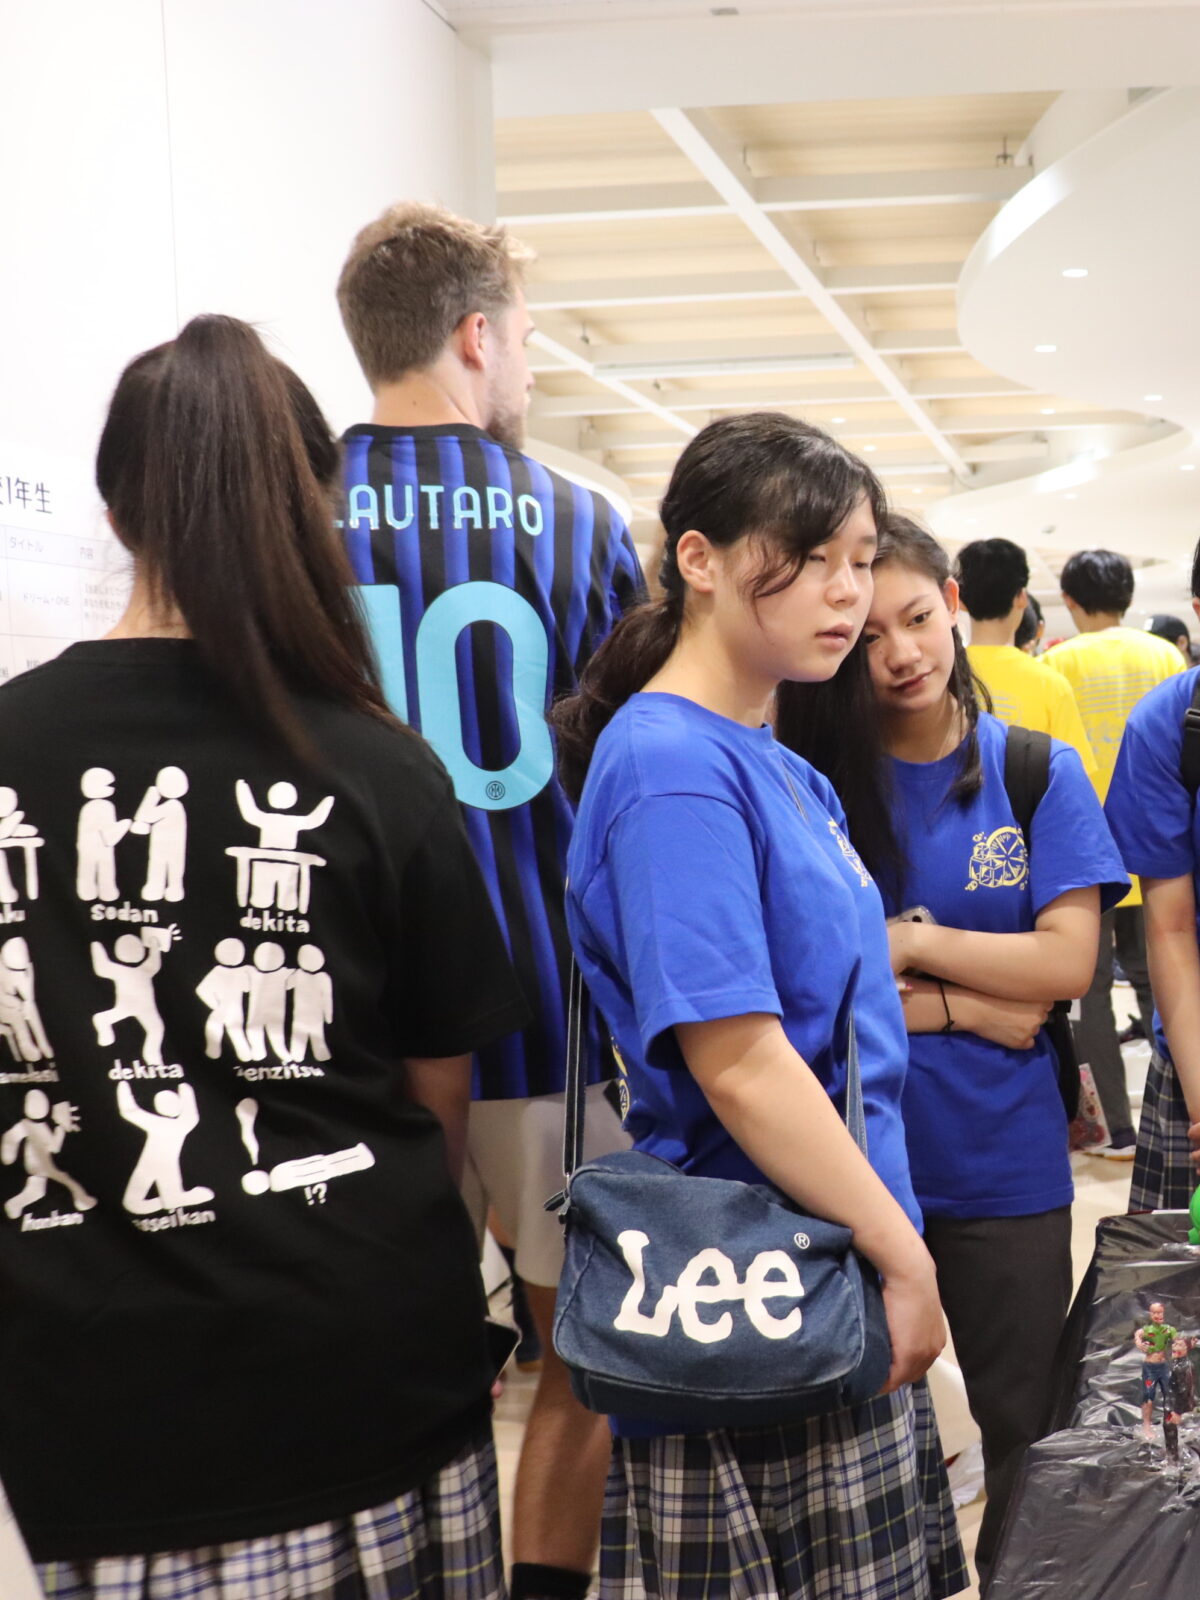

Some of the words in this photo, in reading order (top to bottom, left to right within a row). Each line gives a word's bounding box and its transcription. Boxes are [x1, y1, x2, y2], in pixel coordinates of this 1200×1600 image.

[333, 484, 544, 537] AUTARO
[108, 1059, 184, 1080] dekita
[613, 1230, 805, 1344] Lee
